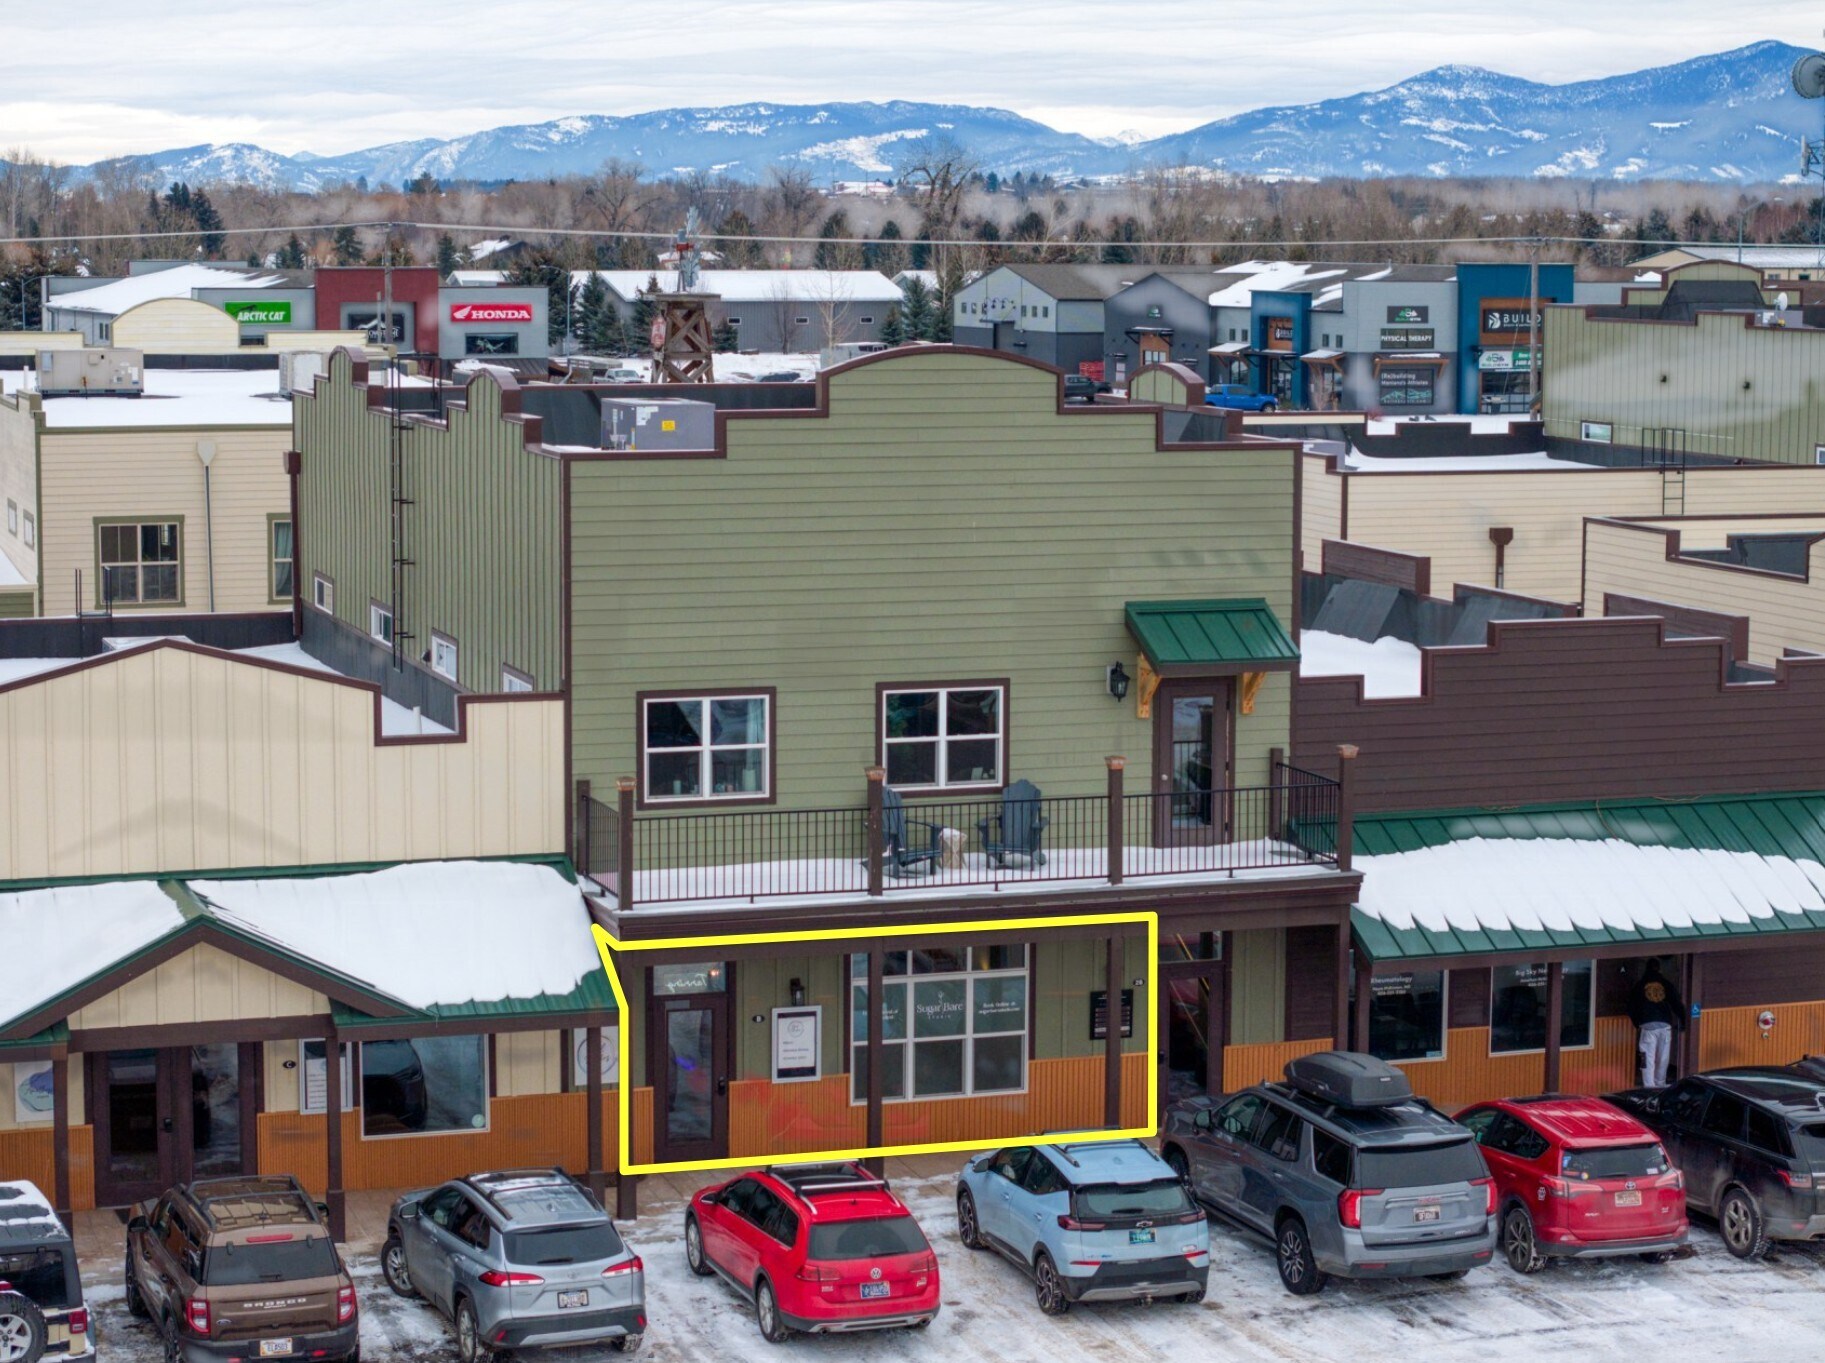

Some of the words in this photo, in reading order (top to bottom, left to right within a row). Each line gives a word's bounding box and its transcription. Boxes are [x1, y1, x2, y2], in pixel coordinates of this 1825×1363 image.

[237, 311, 267, 321] ARCTIC
[268, 311, 286, 321] CAT
[471, 310, 531, 319] HONDA
[1371, 976, 1412, 984] Rheumatology
[917, 1003, 940, 1015] Sugar
[943, 1002, 963, 1012] Bare
[243, 1298, 306, 1308] BRONCO
